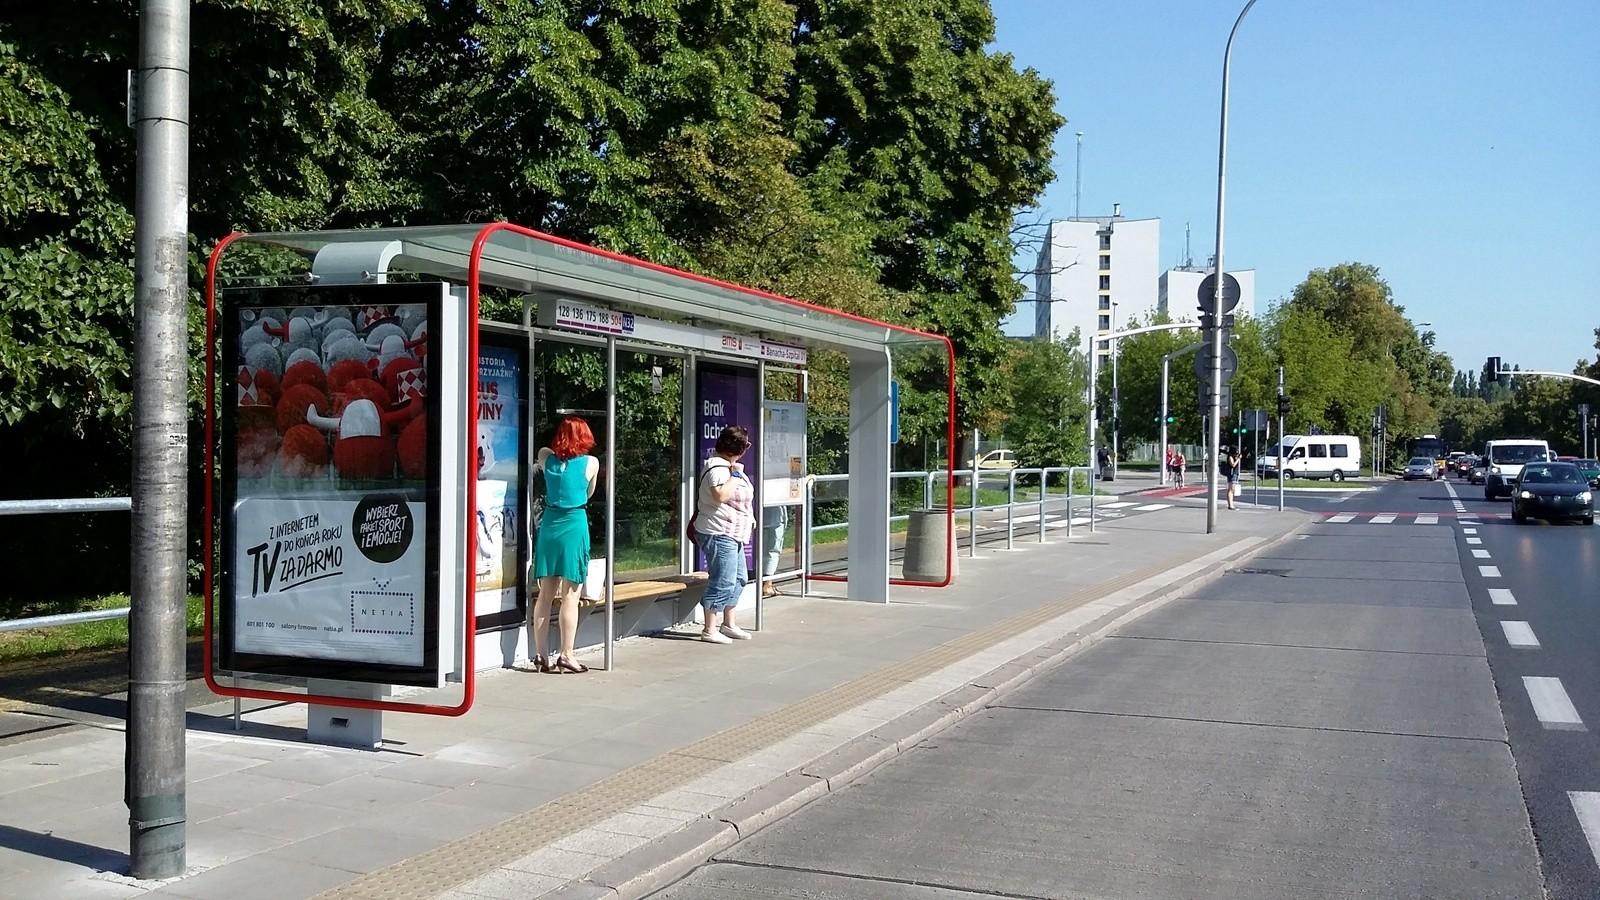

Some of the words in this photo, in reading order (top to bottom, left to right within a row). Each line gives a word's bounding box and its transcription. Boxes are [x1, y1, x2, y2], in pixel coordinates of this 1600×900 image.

[559, 306, 570, 317] 128
[572, 308, 583, 320] 136
[586, 310, 597, 322] 175
[599, 312, 609, 324] 188
[722, 335, 737, 347] ams
[704, 400, 724, 416] Brak
[269, 527, 275, 540] Z
[277, 512, 319, 538] INTERNETEM
[379, 515, 407, 532] SPORT
[284, 540, 294, 553] DO
[322, 525, 342, 543] ROKU
[366, 531, 402, 548] EMOCJE!
[247, 541, 282, 598] TV
[361, 608, 404, 617] NETIA
